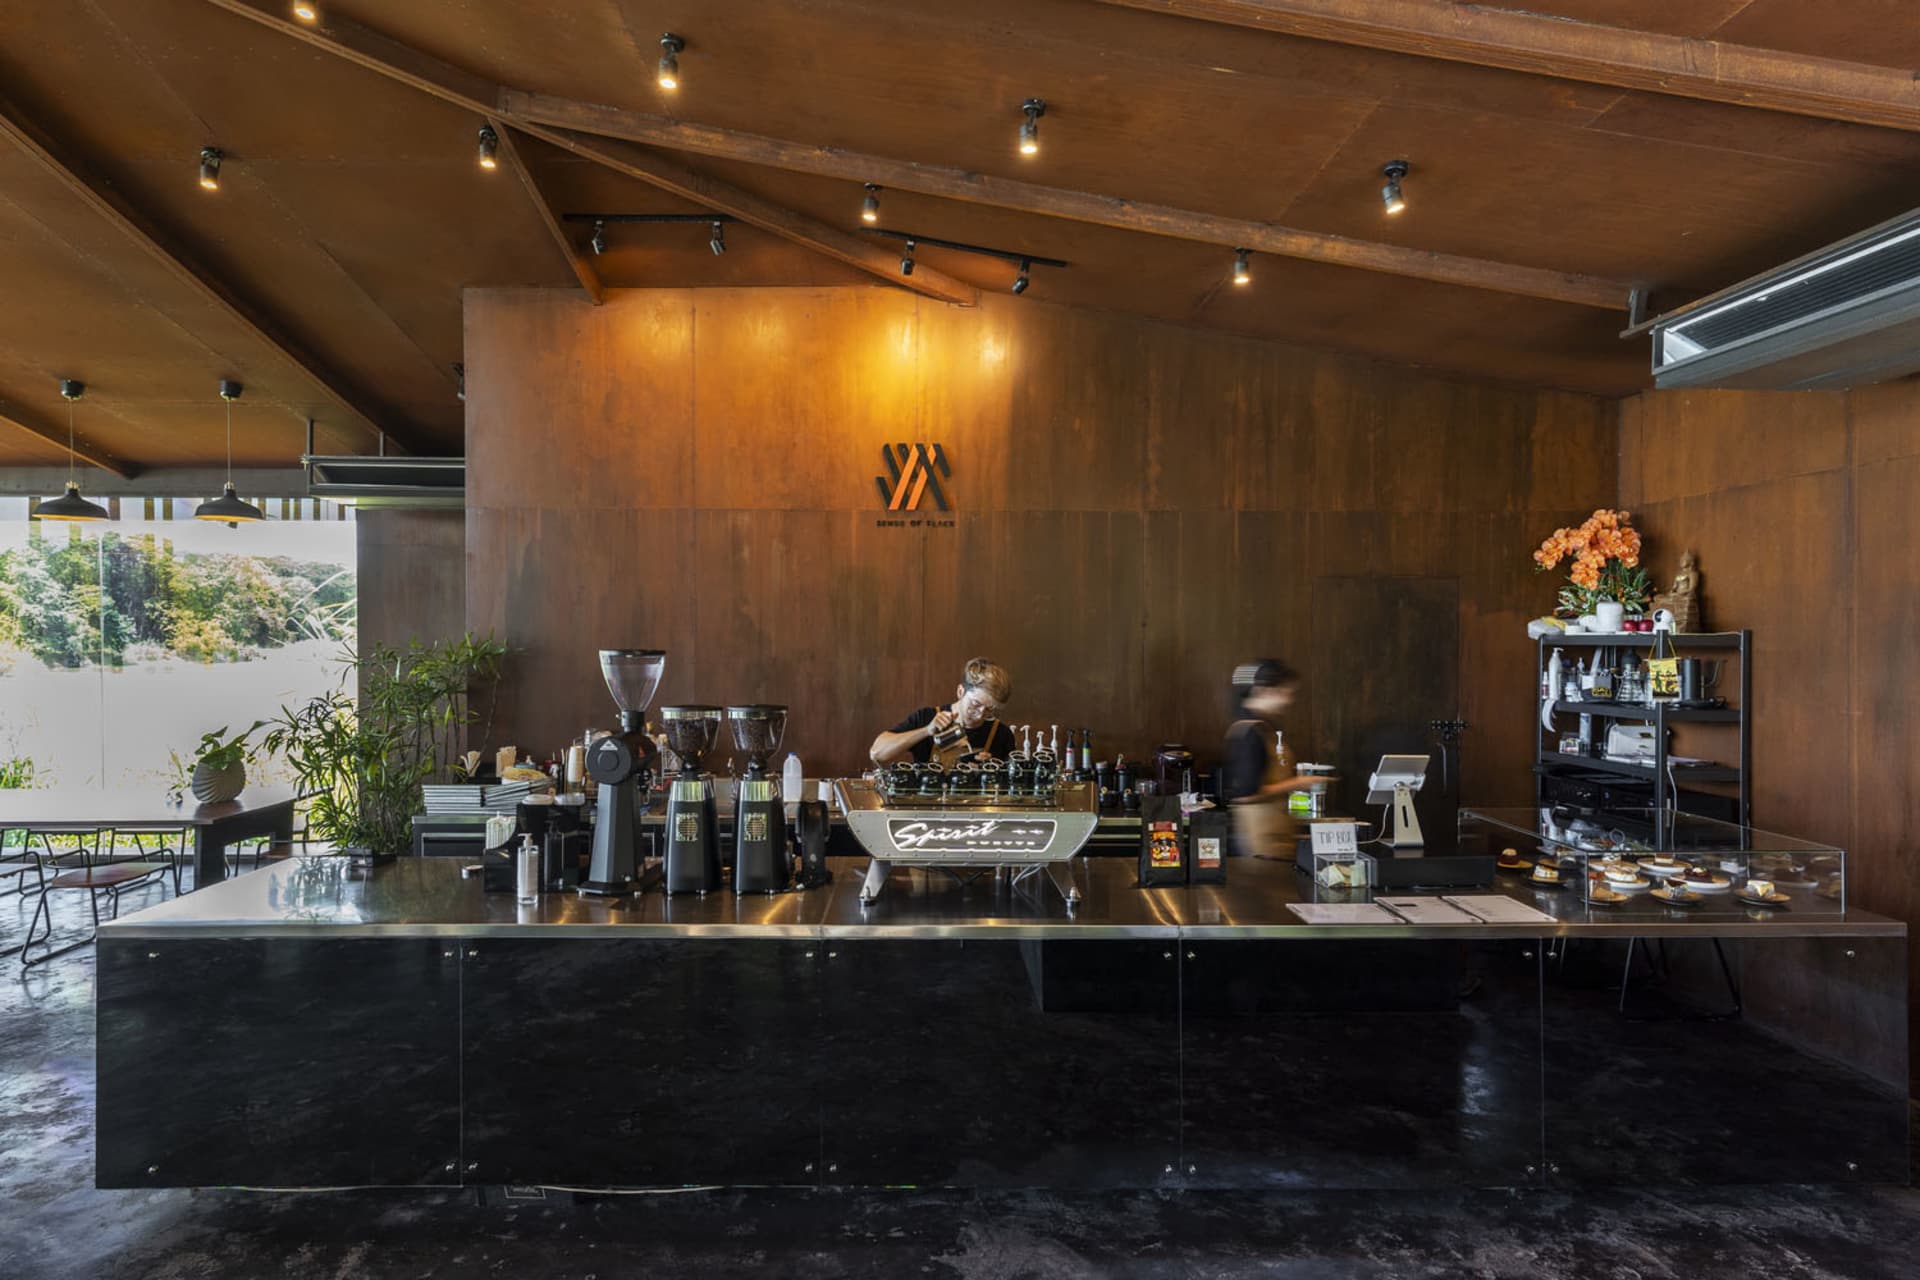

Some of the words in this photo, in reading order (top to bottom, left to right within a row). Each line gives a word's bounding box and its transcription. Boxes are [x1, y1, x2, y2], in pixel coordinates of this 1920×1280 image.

[894, 820, 1000, 847] Spirit
[1315, 831, 1334, 844] TIP
[1335, 831, 1353, 845] BOX
